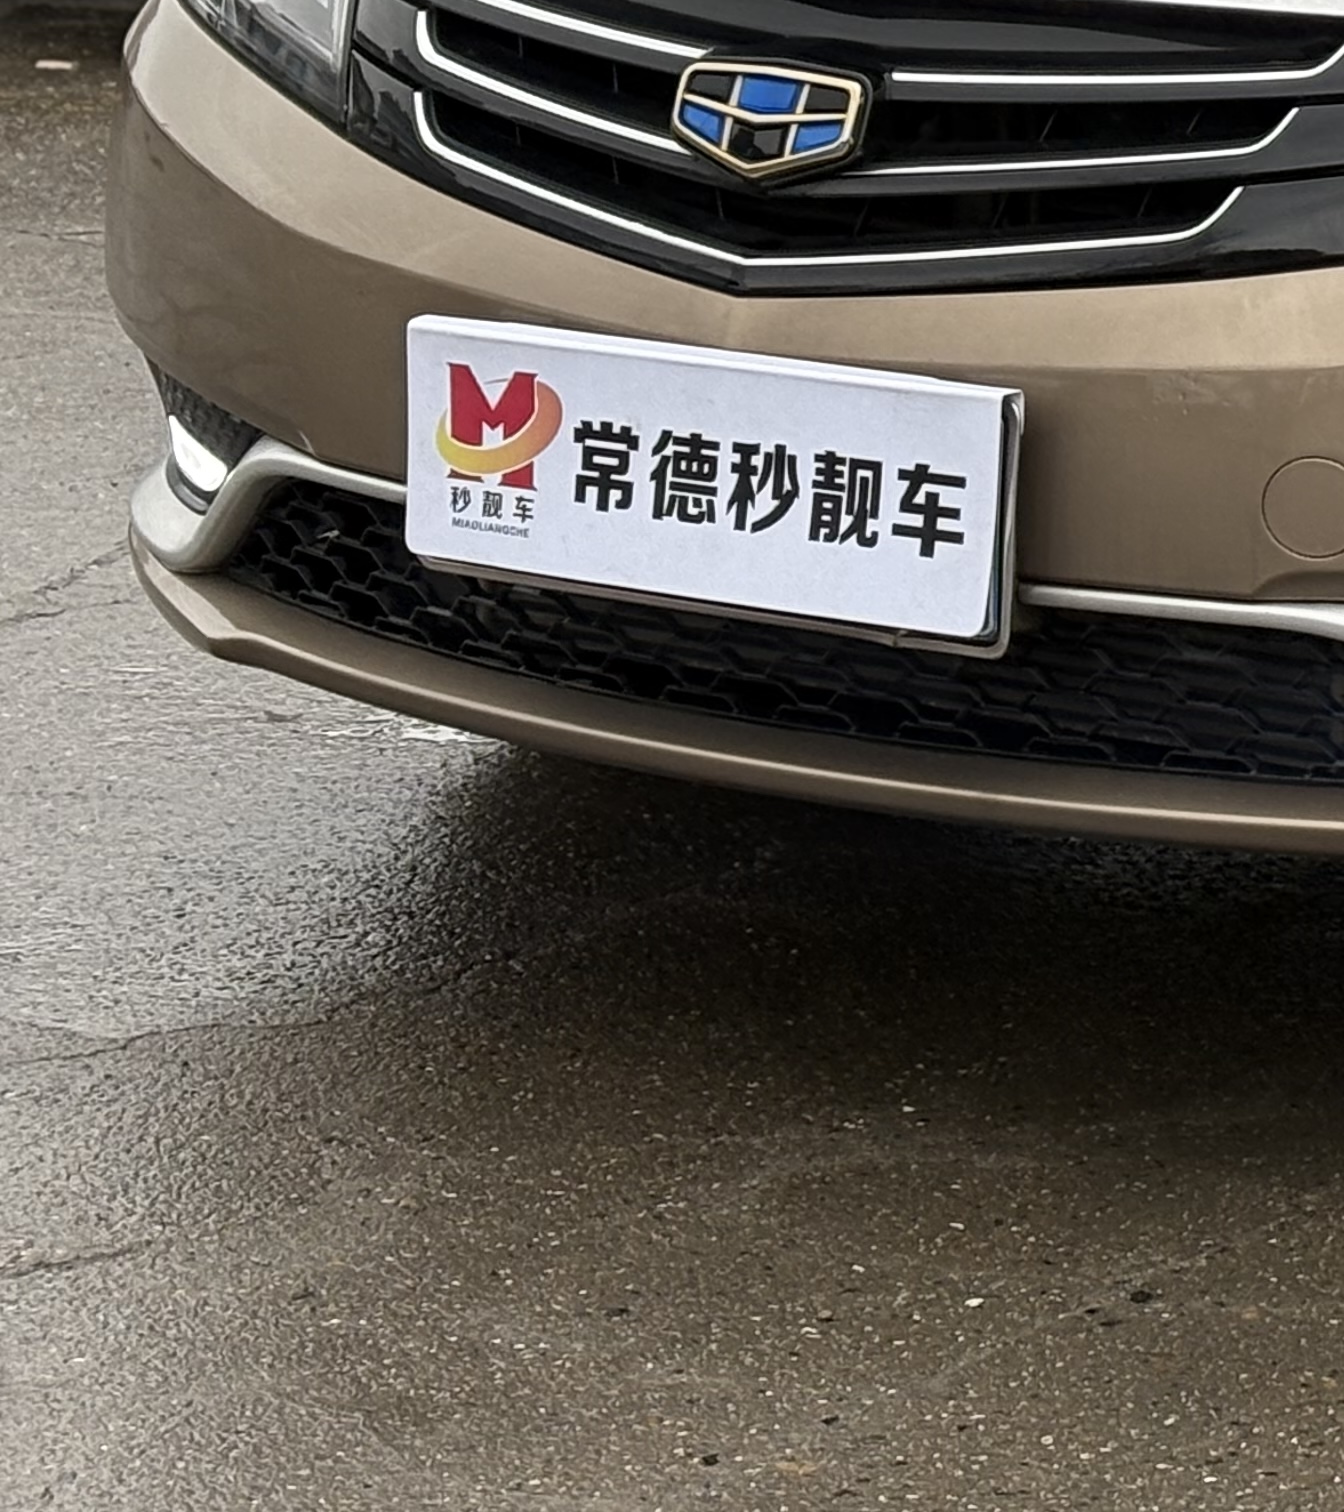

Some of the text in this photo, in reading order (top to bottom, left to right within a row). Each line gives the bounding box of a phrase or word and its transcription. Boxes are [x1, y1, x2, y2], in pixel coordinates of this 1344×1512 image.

[450, 485, 535, 524] 秒靓车
[573, 420, 967, 558] 常德秒靓车
[452, 516, 530, 539] MIAOLIANGCHE
